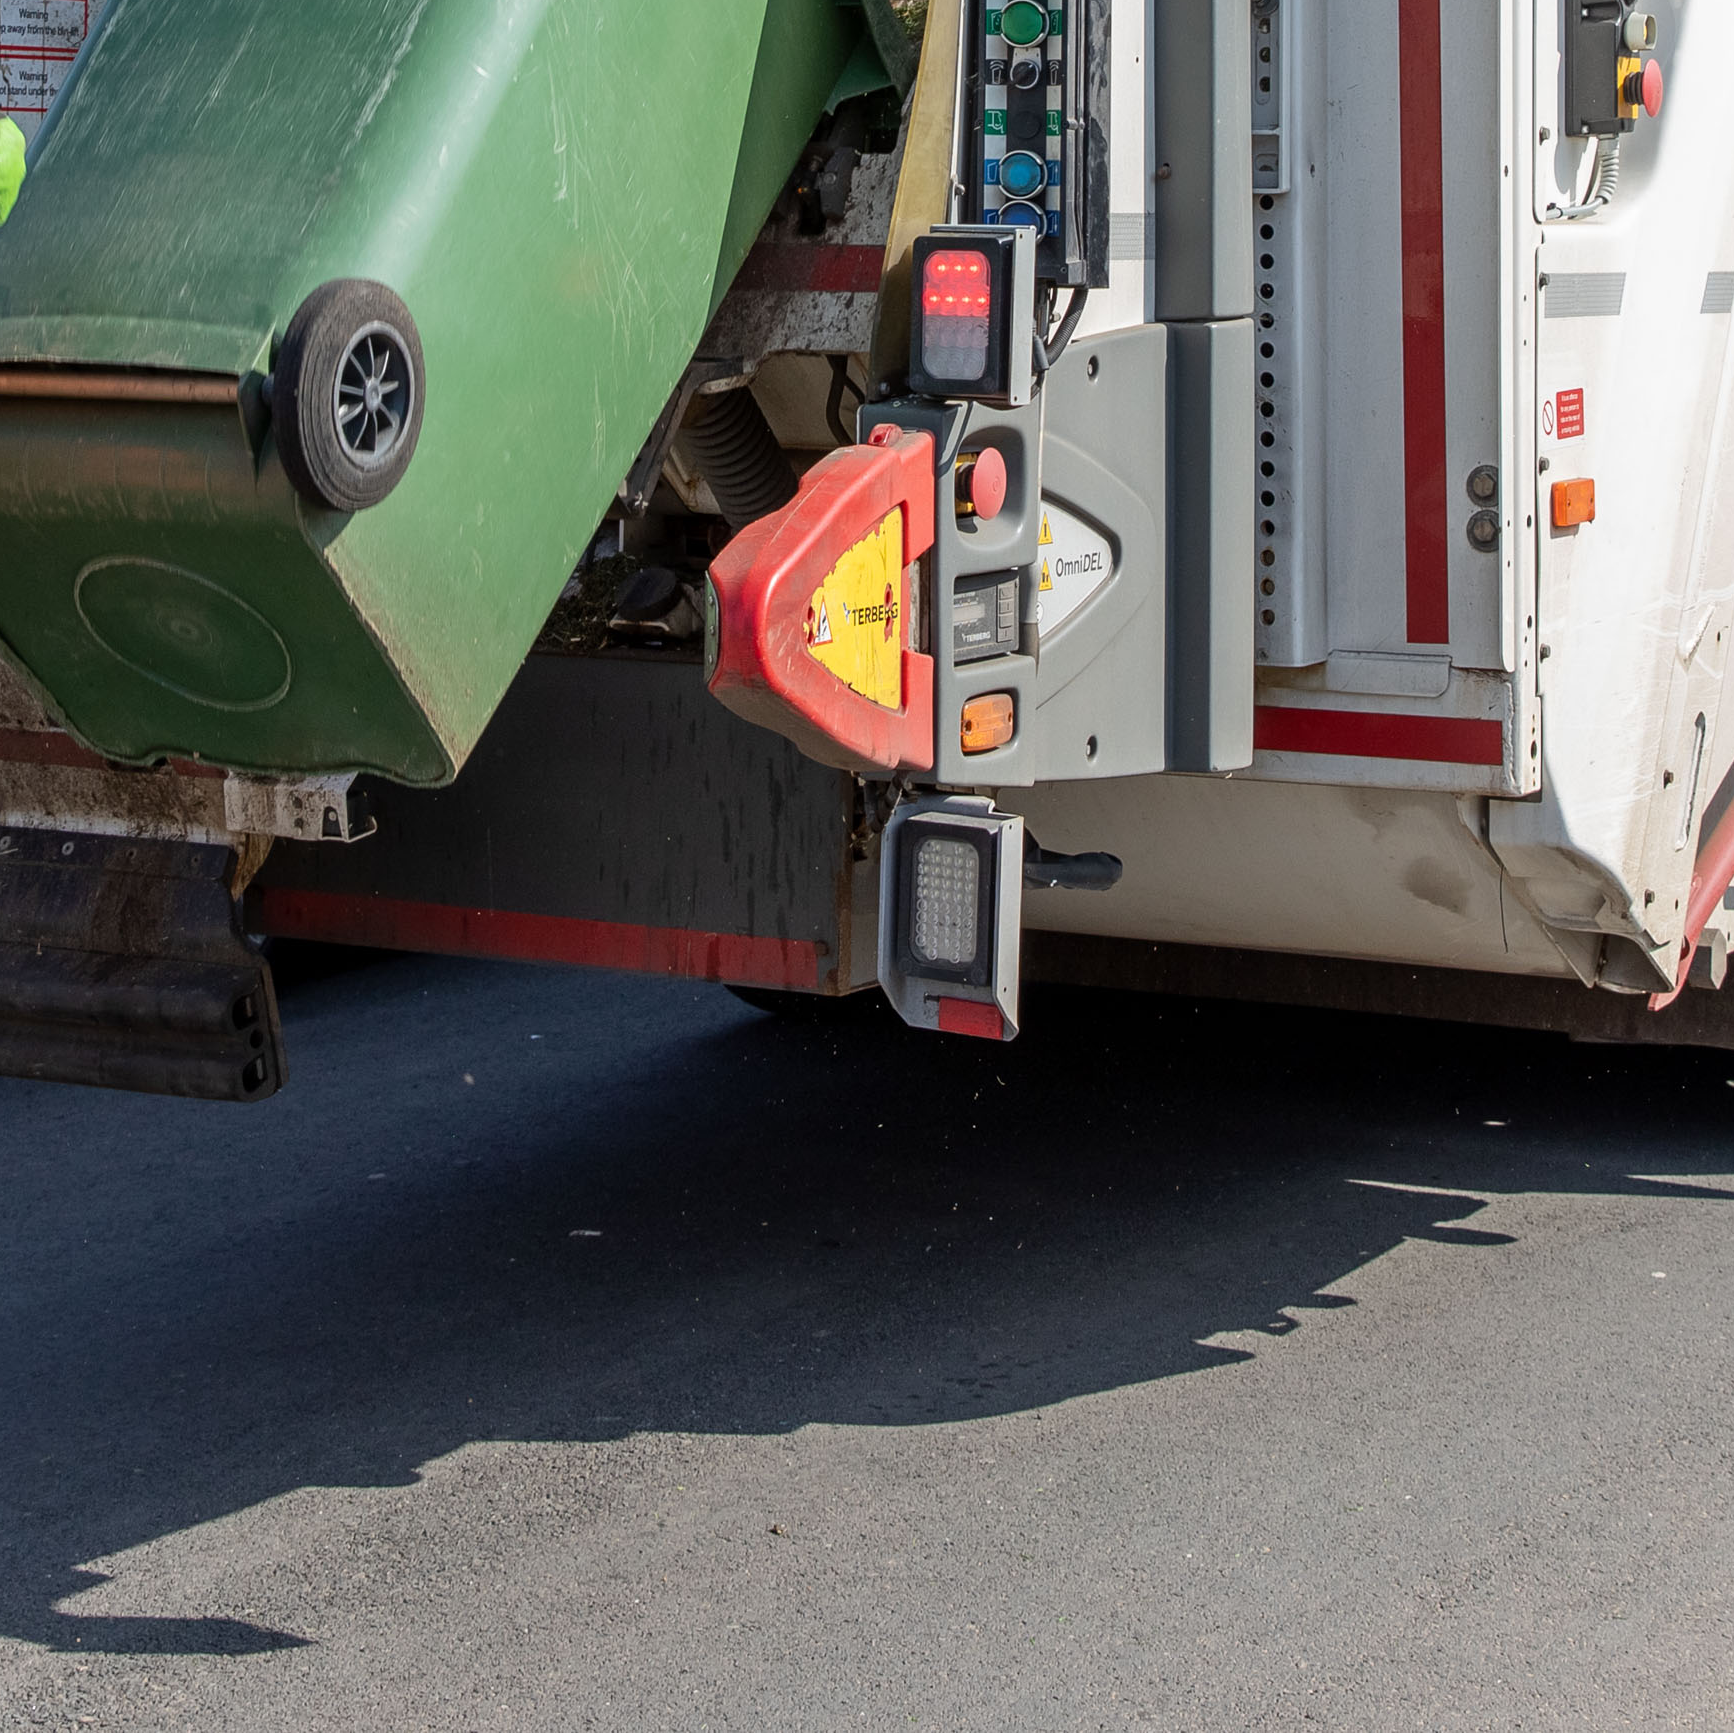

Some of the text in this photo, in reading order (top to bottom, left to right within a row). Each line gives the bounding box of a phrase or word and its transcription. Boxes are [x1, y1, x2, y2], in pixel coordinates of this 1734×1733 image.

[19, 9, 48, 22] Warning
[7, 25, 25, 36] away
[27, 24, 44, 35] from
[46, 25, 56, 35] the
[19, 71, 48, 83] Warning
[8, 86, 27, 95] stand
[28, 86, 47, 96] under
[1056, 552, 1103, 577] OmniDEL
[852, 602, 898, 626] TERBERG
